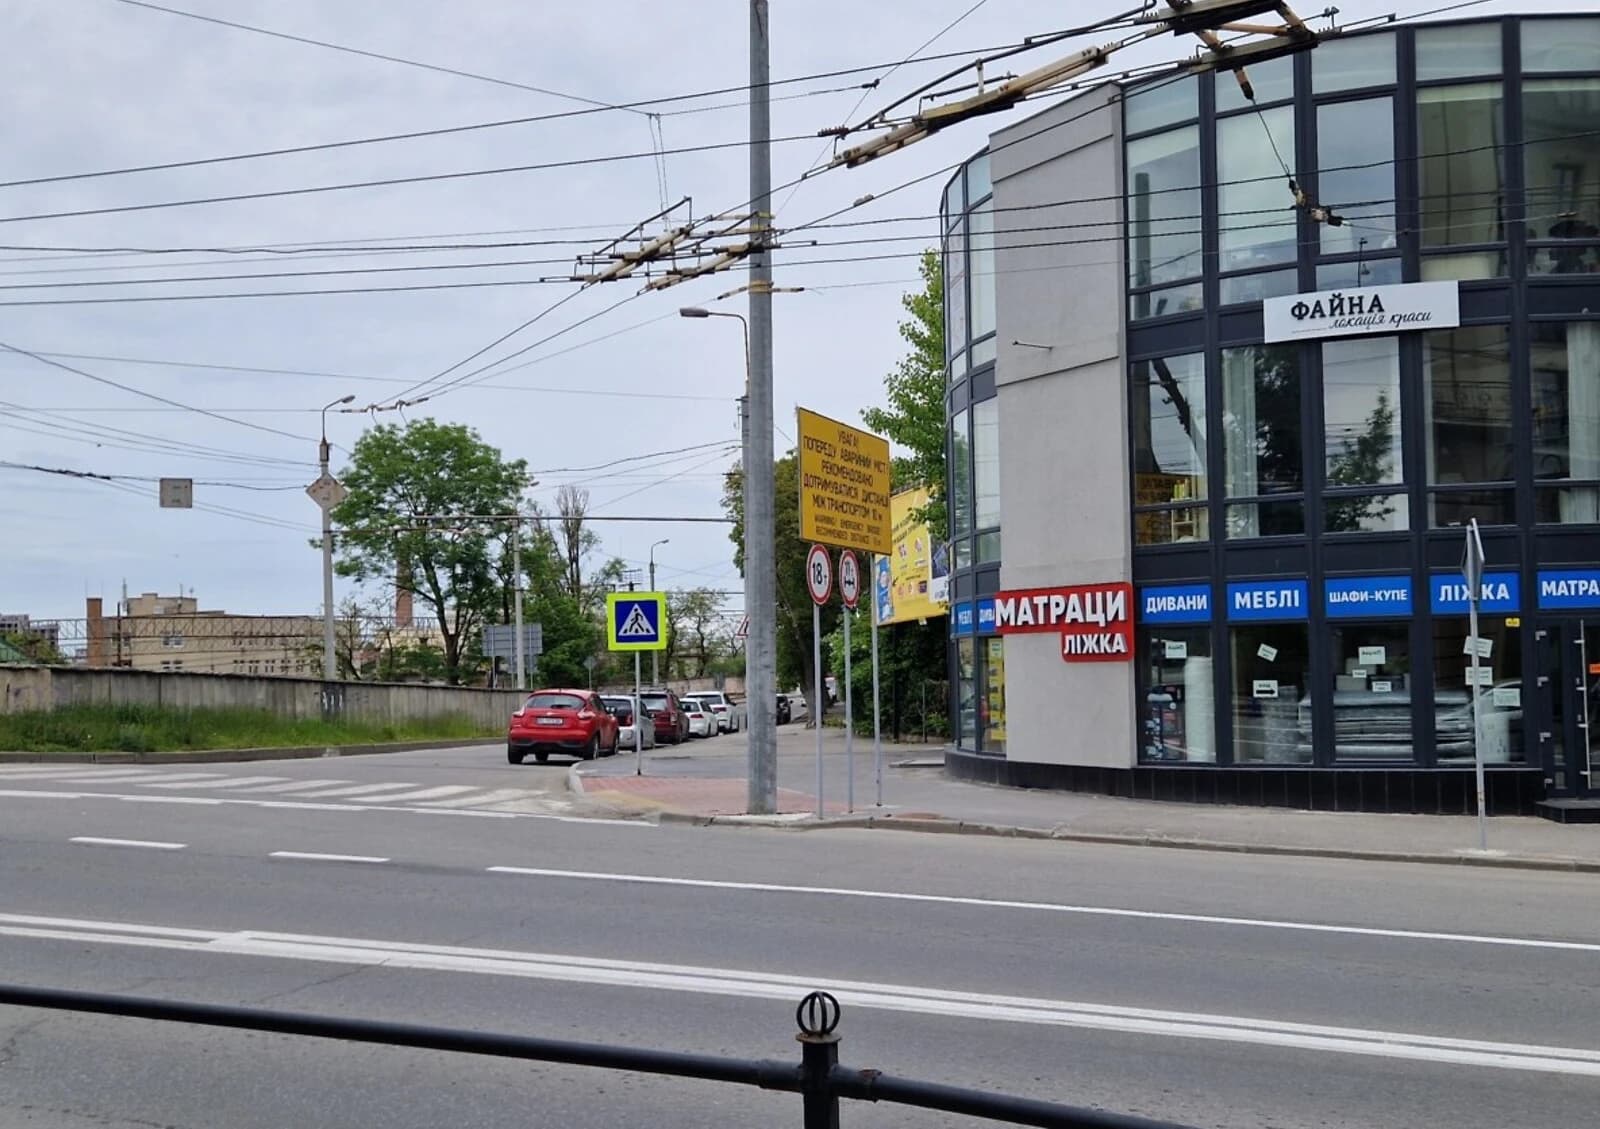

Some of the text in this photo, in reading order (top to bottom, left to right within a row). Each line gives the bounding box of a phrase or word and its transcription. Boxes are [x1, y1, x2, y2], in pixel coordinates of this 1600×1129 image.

[1291, 293, 1385, 320] ФАЙНА
[1328, 311, 1432, 330] локація краси
[1146, 595, 1208, 614] ДИВАНИ
[1234, 589, 1300, 610] МЕБЛІ
[1329, 589, 1408, 603] ШАФИ-КУПЕ
[995, 590, 1127, 627] МАТРАЦИ
[1063, 633, 1128, 655] ЛІЖКА
